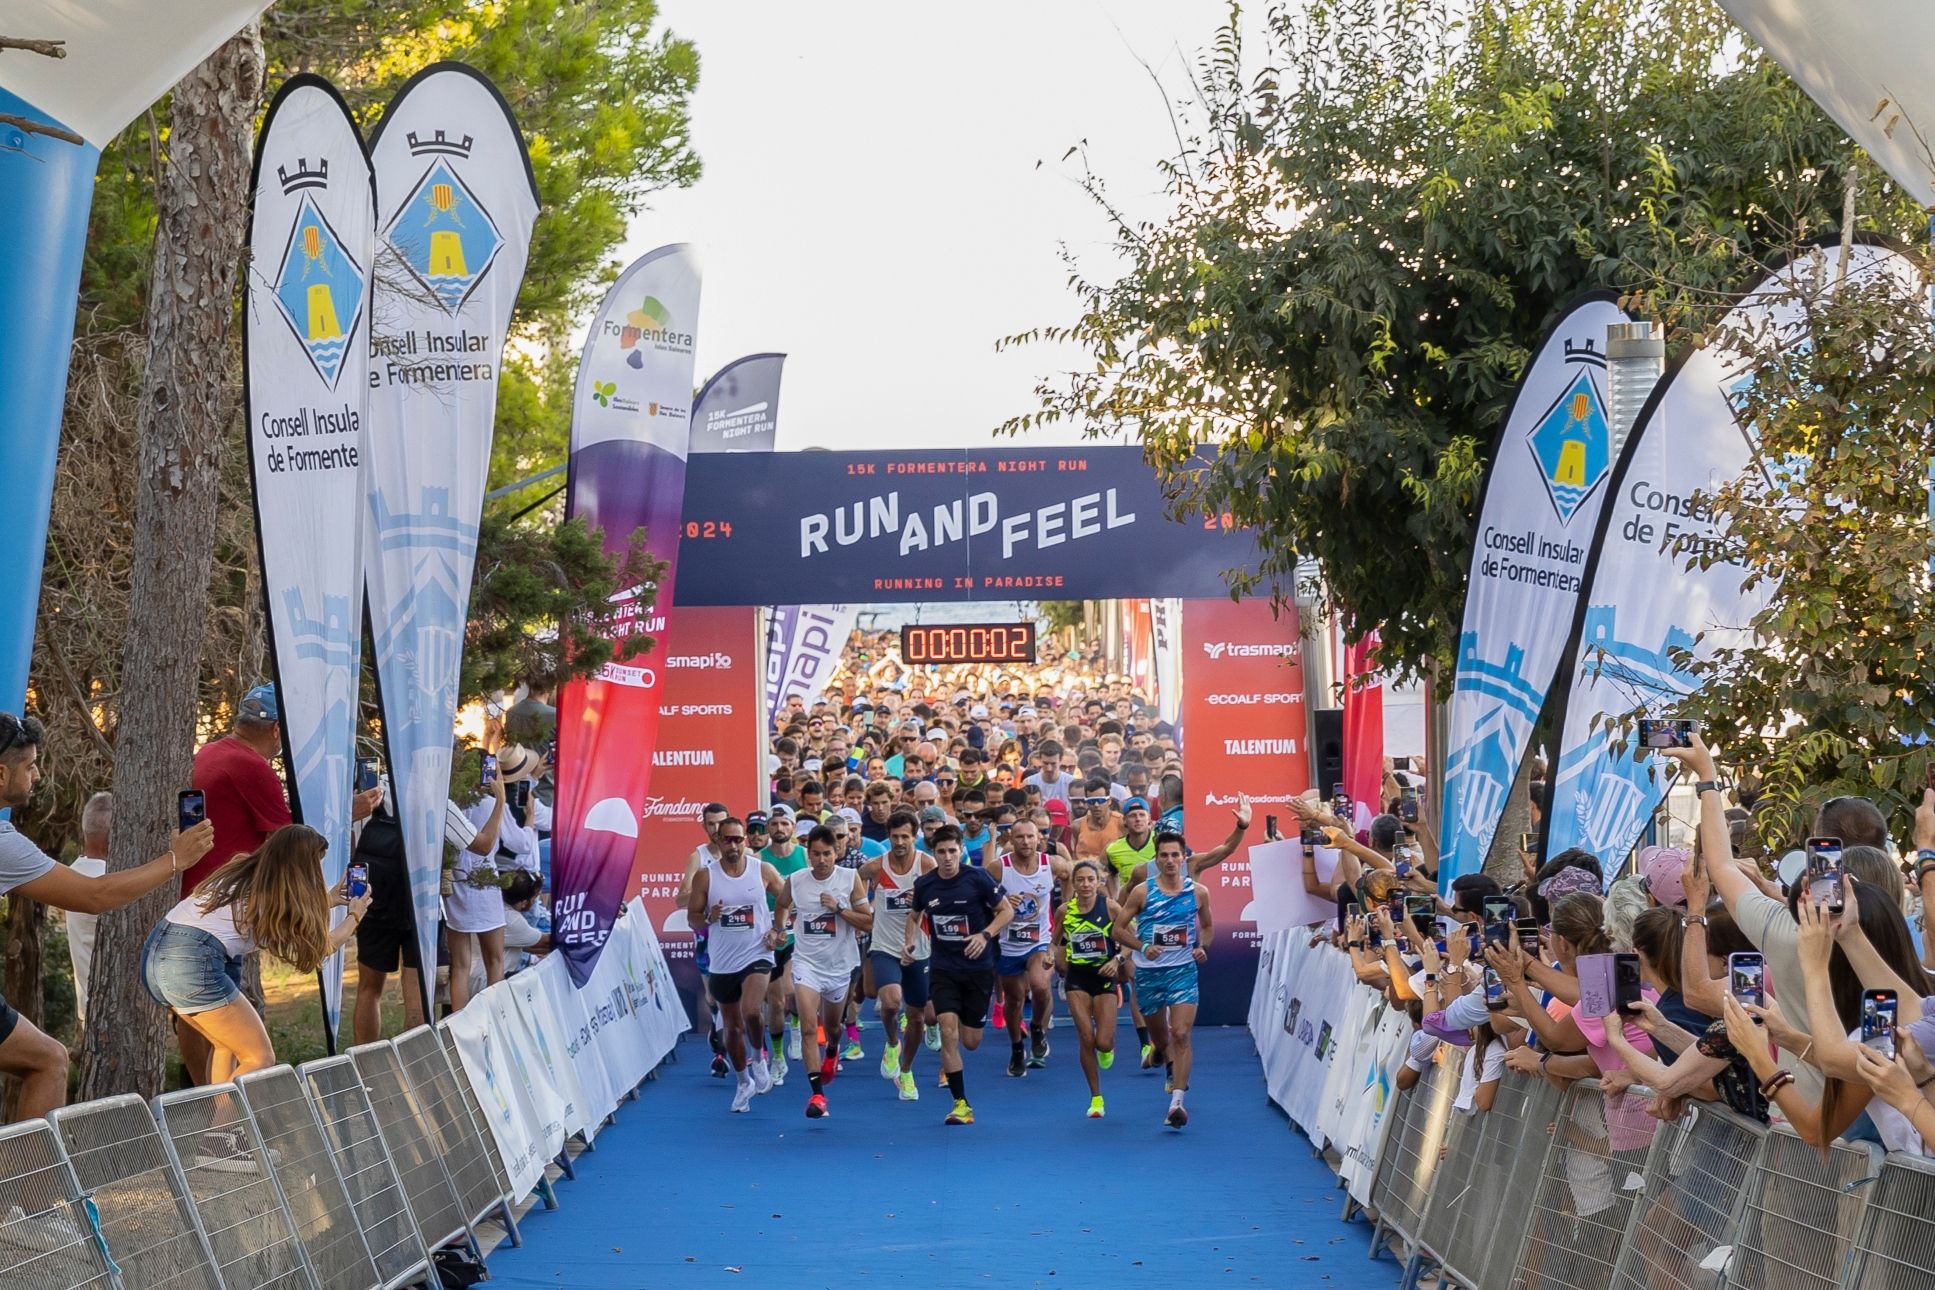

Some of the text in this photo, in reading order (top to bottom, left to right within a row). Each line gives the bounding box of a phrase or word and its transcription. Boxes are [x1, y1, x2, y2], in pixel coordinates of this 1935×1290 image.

[426, 329, 489, 353] Insular
[604, 320, 693, 347] Formentera
[261, 407, 309, 439] Consell
[706, 412, 767, 432] FORMENTERA
[722, 421, 774, 439] NIGHT RUN
[267, 443, 359, 473] de Formente
[847, 459, 1088, 475] 15K FORMENTERA NIGHT RUN
[680, 521, 733, 539] 024
[1623, 514, 1654, 544] de
[1484, 526, 1584, 565] Consell Insular
[874, 576, 1064, 590] RUNNING IN PARADISE
[1481, 553, 1581, 594] de Formentera
[635, 617, 666, 633] RUN
[909, 628, 1027, 659] 00:00:02
[681, 704, 732, 716] SPORTS
[1224, 739, 1297, 755] TALENTUM
[652, 750, 715, 766] ALENTUM
[1221, 876, 1251, 887] PAR
[641, 887, 679, 898] PARA
[559, 910, 596, 933] AND
